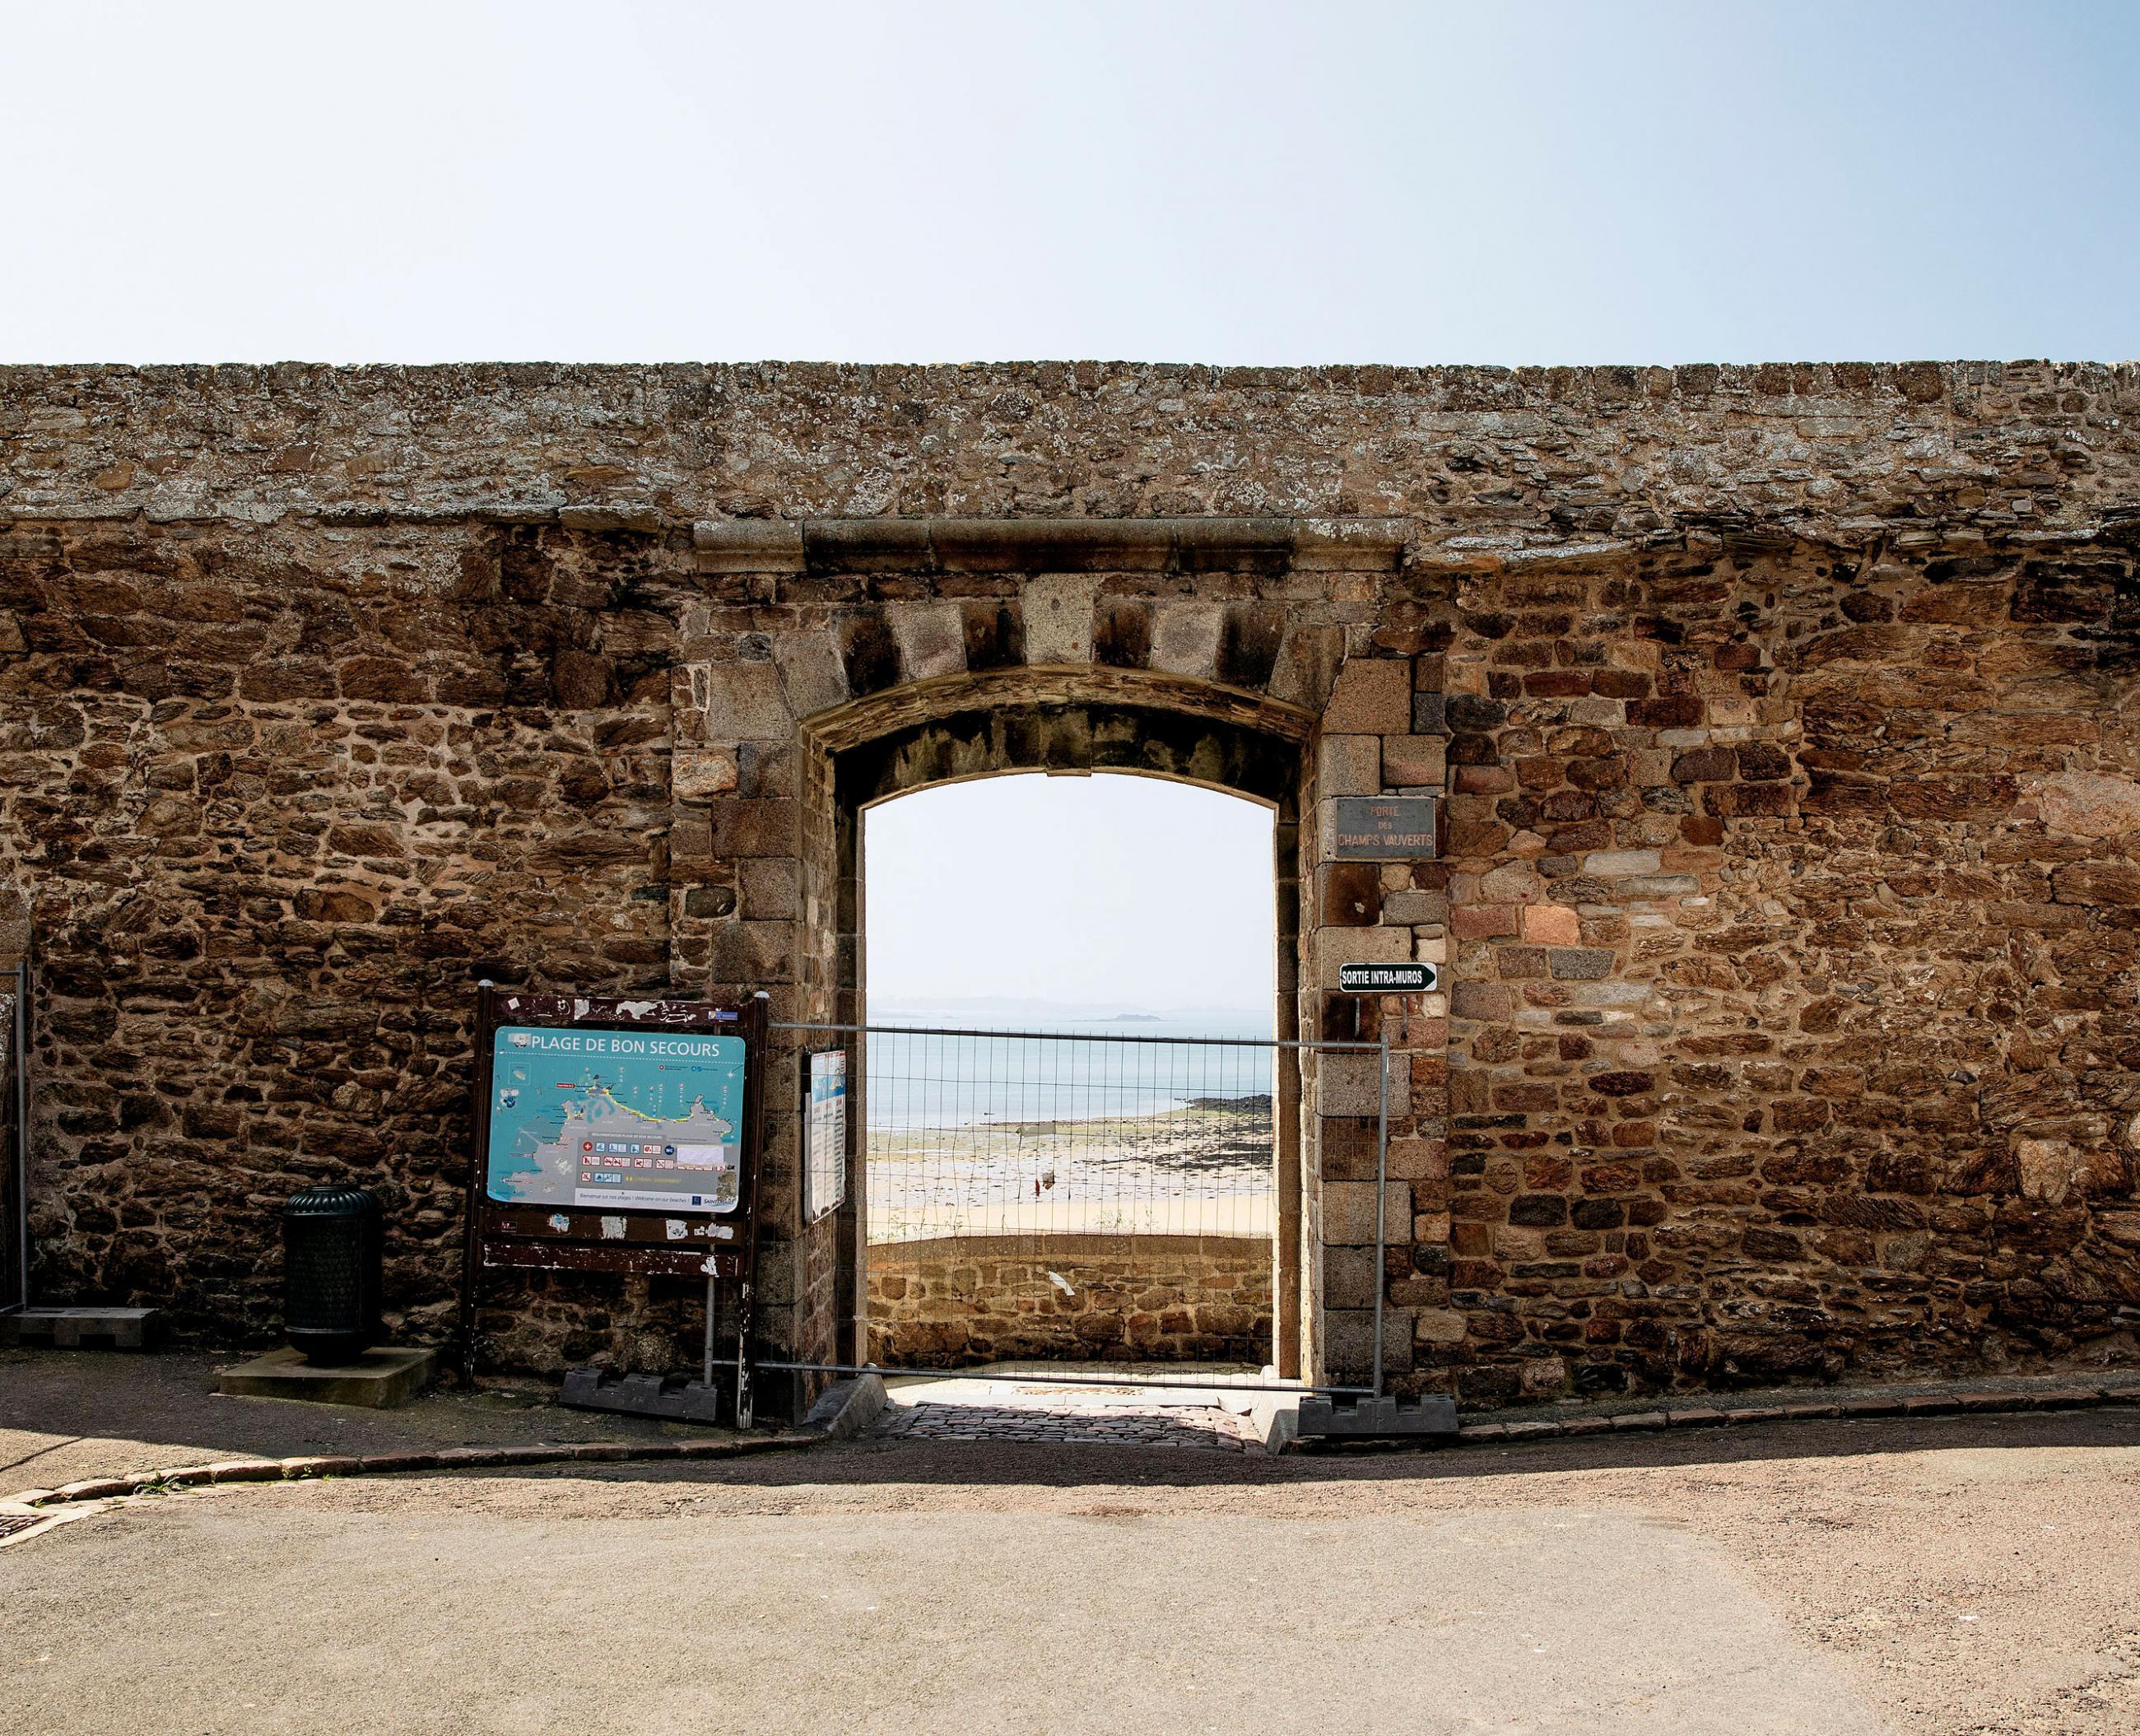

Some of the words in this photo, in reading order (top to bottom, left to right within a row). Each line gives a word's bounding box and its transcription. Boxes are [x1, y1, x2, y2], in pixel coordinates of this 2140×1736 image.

[1370, 806, 1399, 817] PORTE
[1338, 834, 1380, 846] CHAMPS
[1383, 834, 1433, 846] VAUVERTS
[1342, 970, 1370, 984] SORTIE
[1371, 970, 1422, 984] INTRA-MUROS
[532, 1036, 580, 1050] PLAGE
[586, 1038, 605, 1052] DE
[612, 1039, 644, 1054] BON
[650, 1040, 720, 1057] SECOURS
